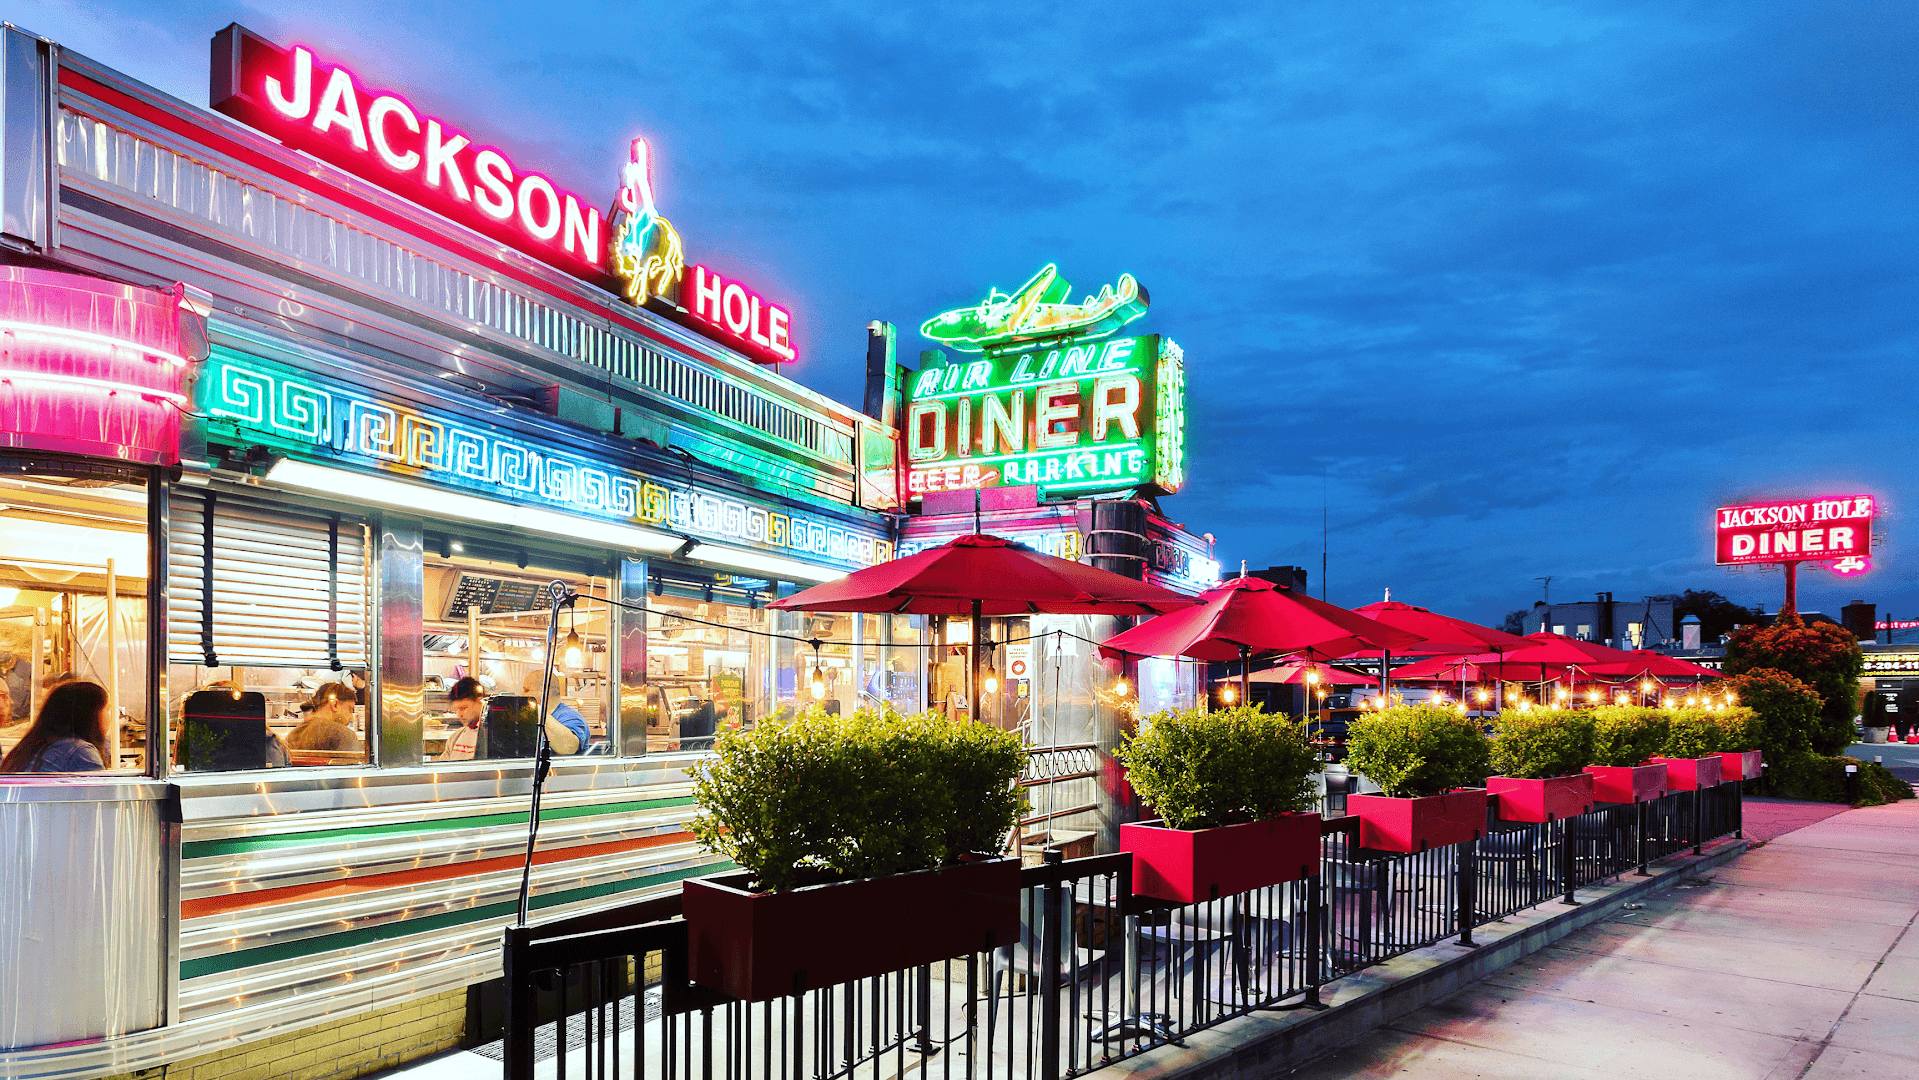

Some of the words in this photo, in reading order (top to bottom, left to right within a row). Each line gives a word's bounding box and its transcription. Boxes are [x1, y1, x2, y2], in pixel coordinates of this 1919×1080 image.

[265, 47, 600, 265] JACKSON
[696, 266, 796, 360] HOLE
[914, 360, 993, 398] AIR
[1010, 338, 1137, 382] LINE
[908, 374, 1141, 461] DINER
[909, 464, 998, 492] BEER
[1004, 449, 1146, 484] PARKING
[1720, 504, 1808, 529] JACKSON
[1812, 498, 1871, 521] HOLE
[1767, 521, 1820, 532] AIRLINE
[1732, 526, 1854, 557] DINER
